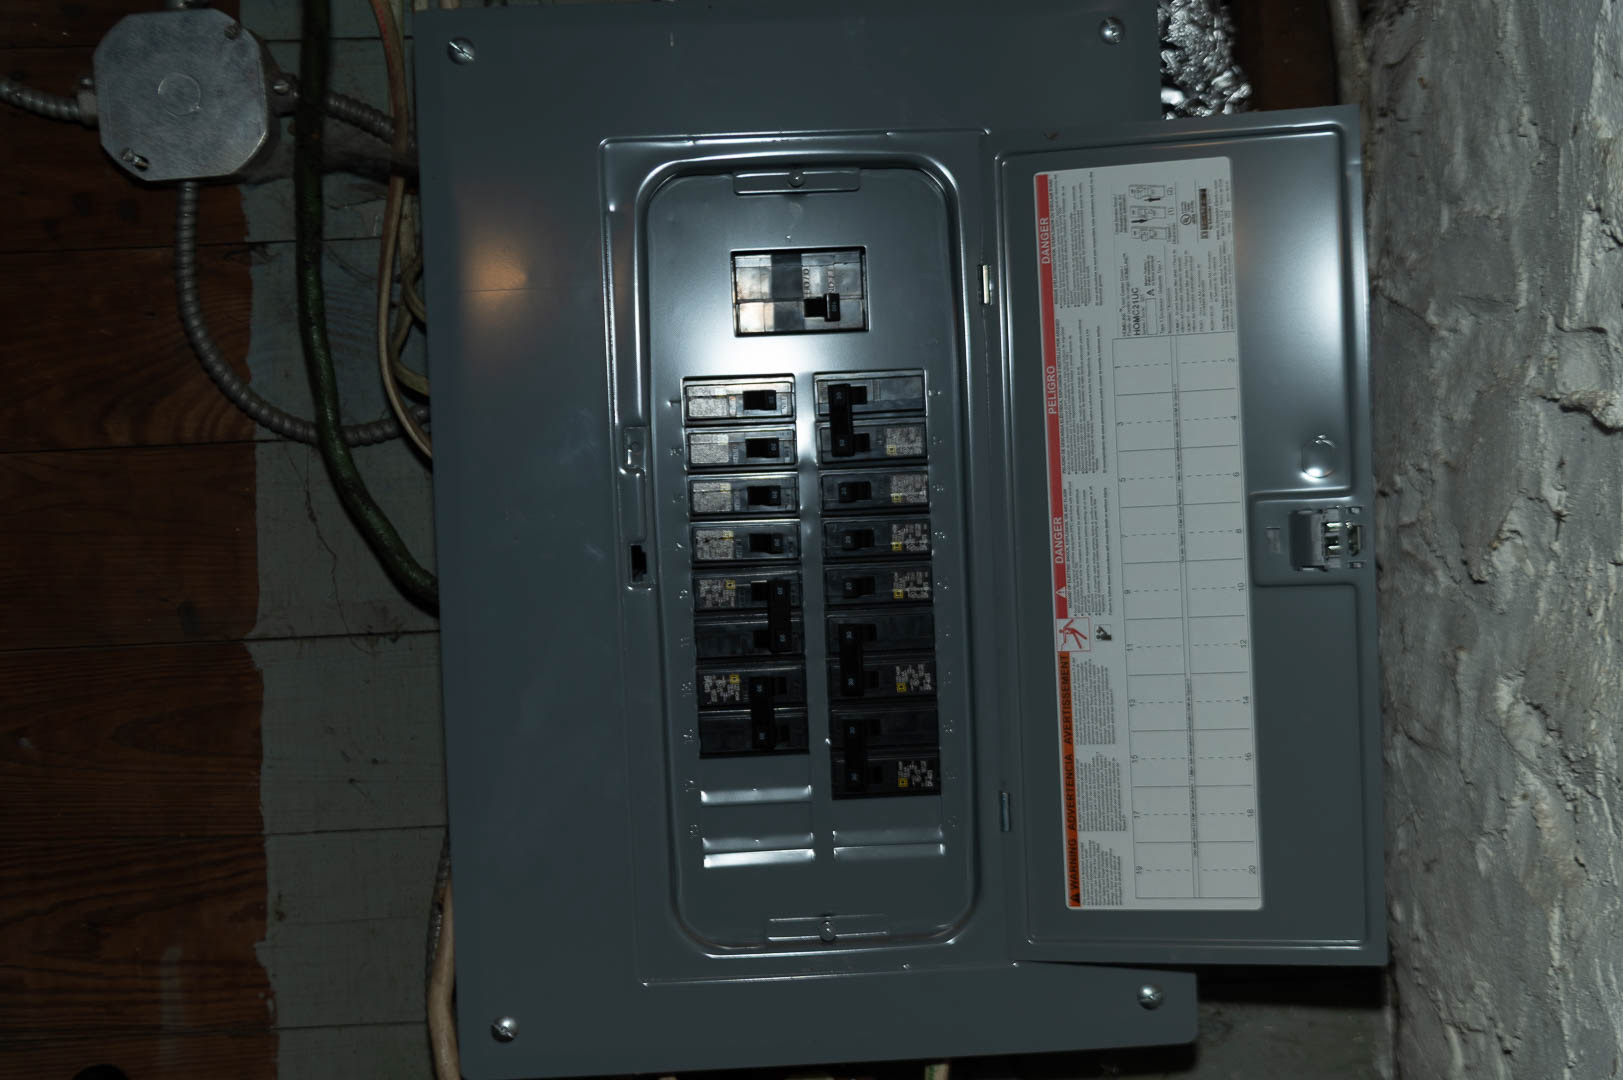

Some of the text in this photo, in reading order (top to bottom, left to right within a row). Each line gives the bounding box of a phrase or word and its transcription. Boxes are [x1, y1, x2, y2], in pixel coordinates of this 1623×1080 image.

[1039, 217, 1050, 264] DANGER
[1131, 288, 1141, 335] HOMC21UC
[1046, 366, 1057, 414] PELIGRO
[1053, 517, 1064, 564] DANGER
[1237, 582, 1244, 591] 10
[1126, 643, 1133, 651] 11
[1240, 639, 1247, 648] 12
[1242, 695, 1249, 704] 14
[1131, 754, 1138, 763] 15
[1061, 655, 1078, 889] WARNING ADVERTENCIA AVERTISSEMENT
[1133, 811, 1140, 819] 17
[1247, 808, 1254, 818] 18
[1136, 865, 1143, 874] 19
[1248, 865, 1256, 875] 20
